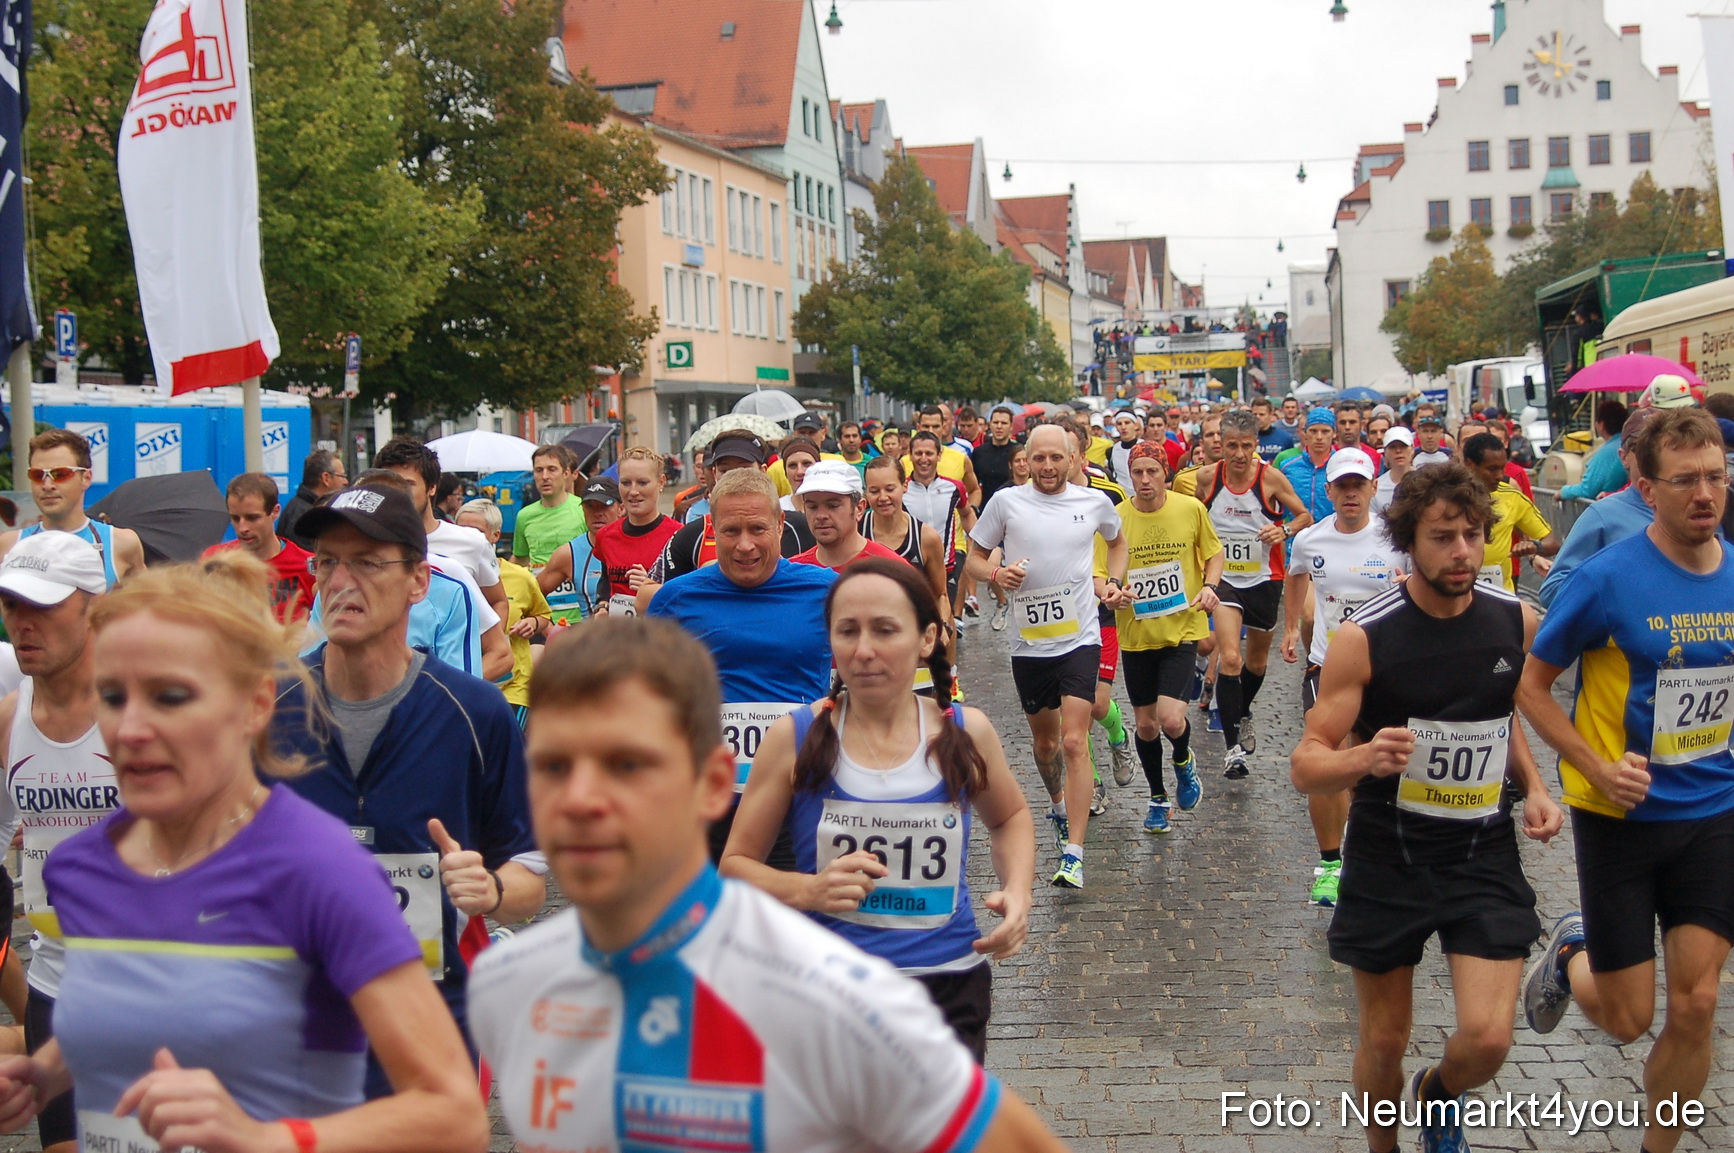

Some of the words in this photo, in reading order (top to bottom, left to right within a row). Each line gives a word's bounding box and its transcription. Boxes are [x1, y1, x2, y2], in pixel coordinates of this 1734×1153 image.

[60, 318, 73, 352] P
[669, 344, 690, 365] D
[1170, 356, 1208, 367] START
[88, 428, 107, 448] XI
[137, 429, 180, 457] DIXI
[262, 427, 287, 447] IXI
[1224, 544, 1250, 559] 161
[1229, 563, 1245, 571] Erich
[1033, 591, 1061, 600] Neumarkt
[1134, 574, 1179, 599] 2260
[1026, 600, 1064, 624] 575
[1148, 600, 1173, 610] Roland
[1646, 616, 1669, 630] 10.
[1659, 679, 1692, 688] PARTL
[1694, 675, 1734, 687] Neumarkt
[720, 712, 746, 721] ARTL
[748, 712, 790, 721] Neuma
[1676, 689, 1729, 727] 242
[722, 725, 769, 758] 30
[1411, 729, 1447, 741] PARTL
[1451, 731, 1495, 742] Neumarkt
[1677, 730, 1716, 750] Michael
[1427, 745, 1493, 781] 507
[39, 772, 87, 784] TEAM
[15, 785, 121, 813] ERDINGER
[1425, 788, 1483, 805] Thorsten
[824, 812, 867, 828] PARTL
[872, 817, 937, 828] Neumarkt
[832, 834, 947, 880] 2613
[386, 867, 412, 878] arkt
[859, 893, 926, 911] vetlana
